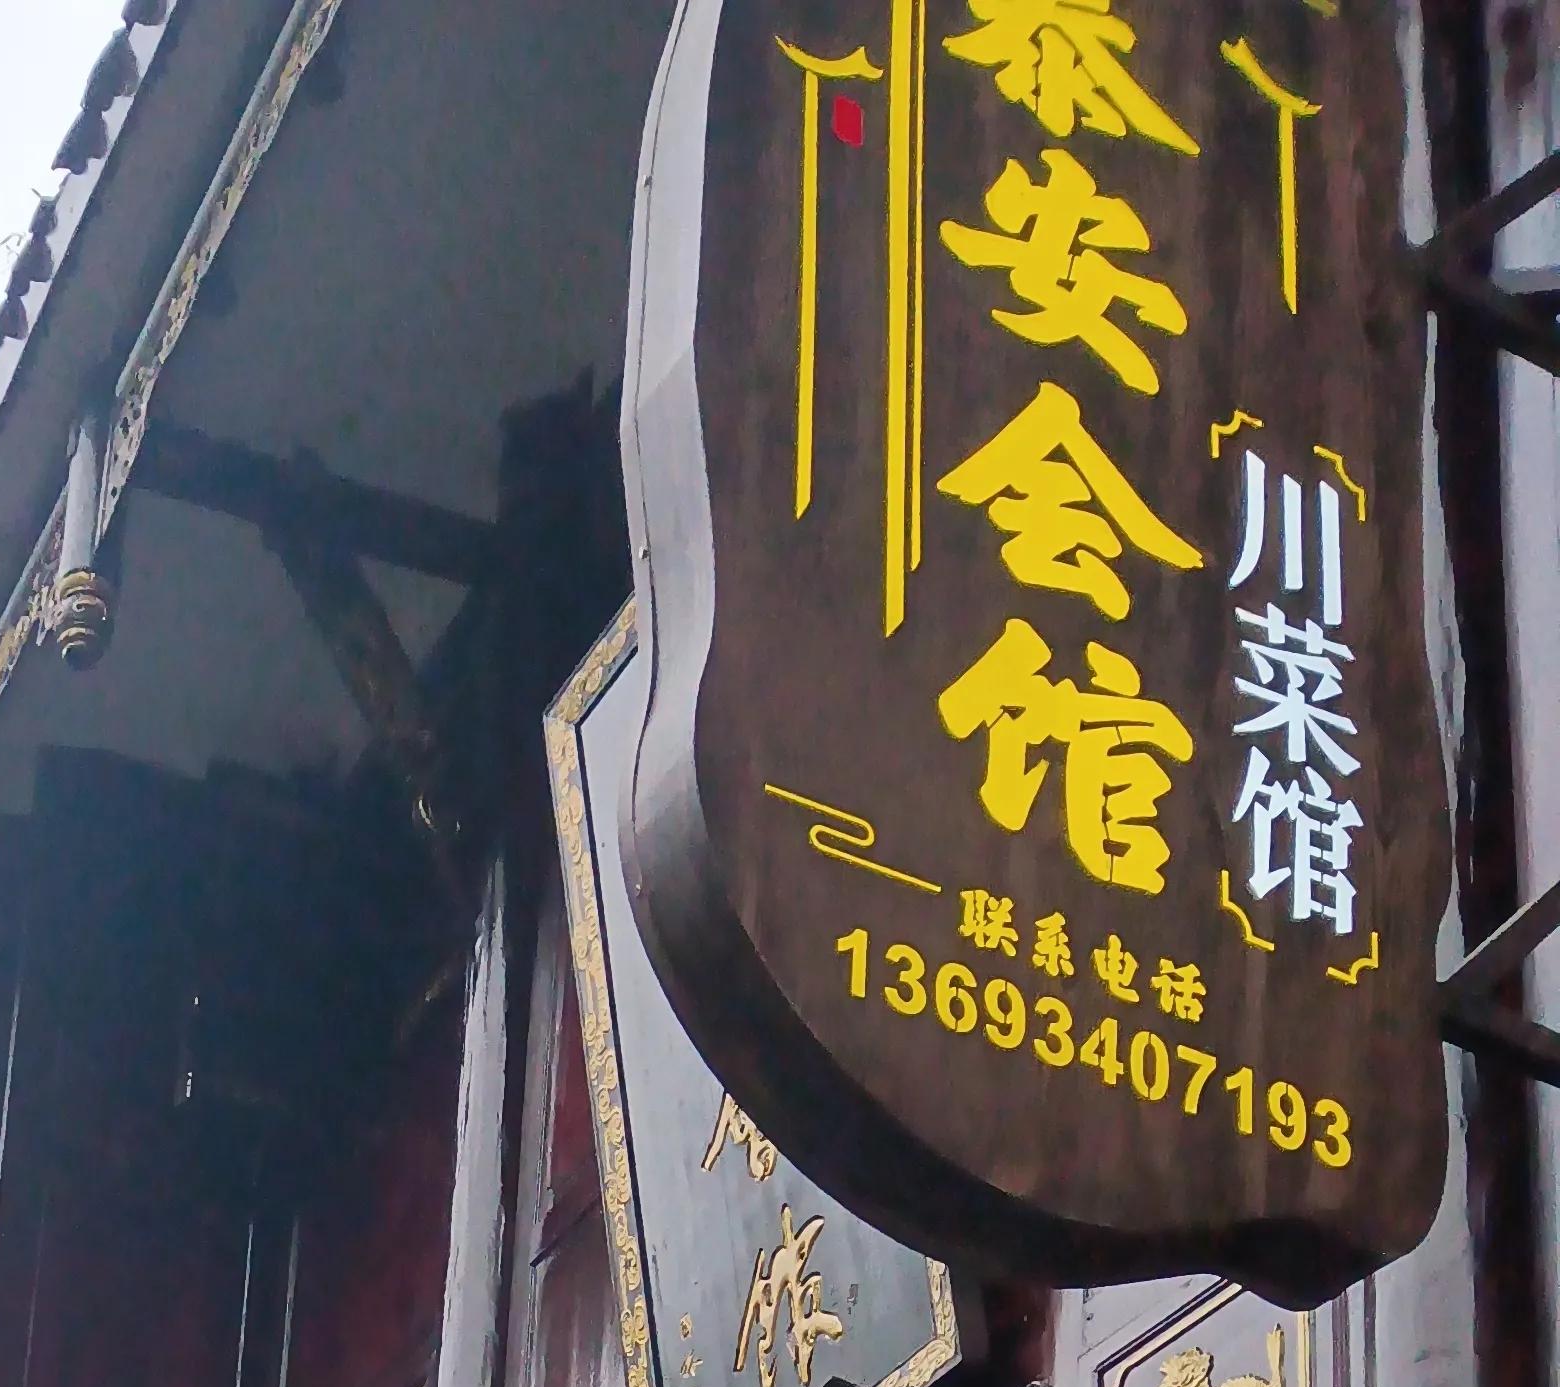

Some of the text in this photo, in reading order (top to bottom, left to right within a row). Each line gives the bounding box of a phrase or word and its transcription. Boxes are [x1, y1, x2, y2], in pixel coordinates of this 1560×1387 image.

[937, 0, 1205, 895] 泰安会馆
[1228, 447, 1364, 936] 川菜馆
[835, 927, 1353, 1169] 13693407193
[957, 887, 1208, 1025] 联系电话
